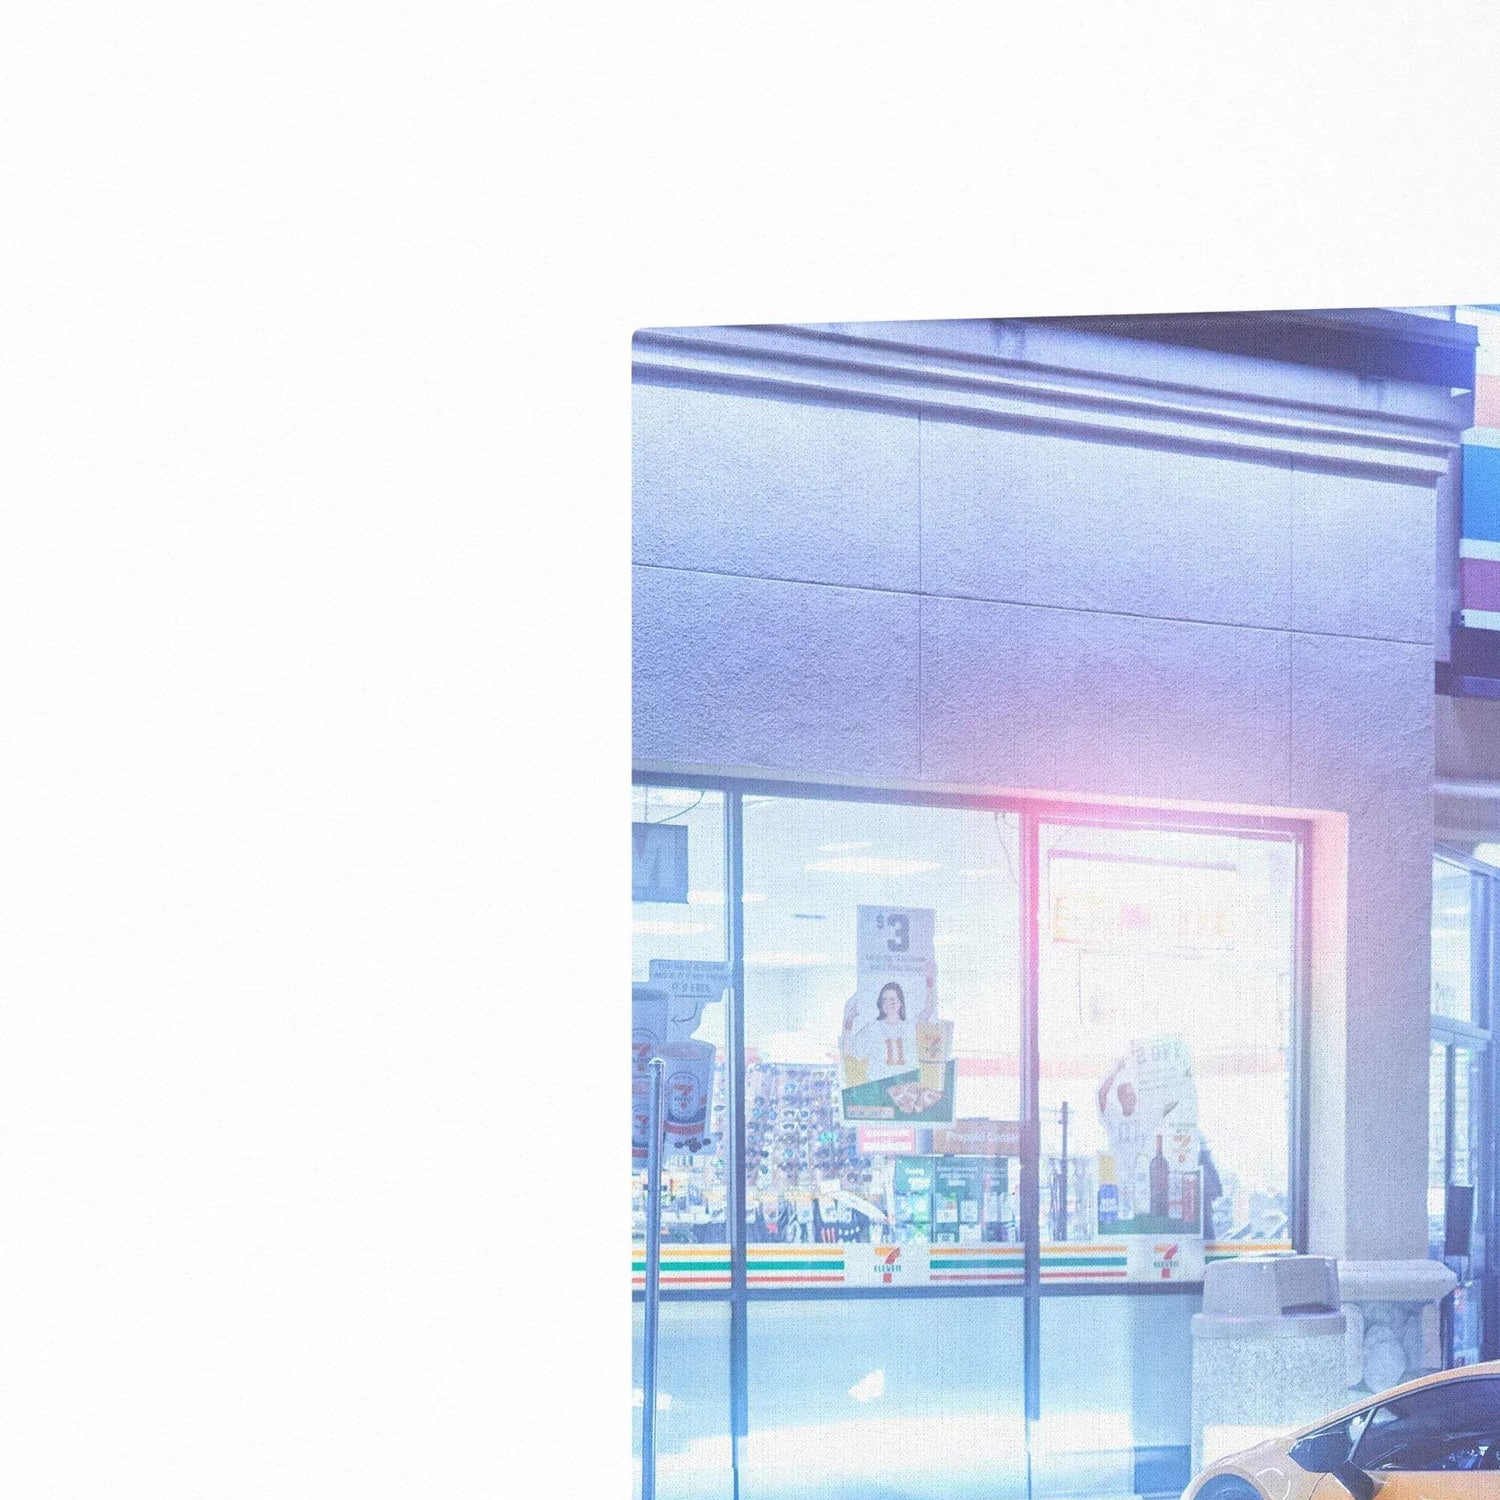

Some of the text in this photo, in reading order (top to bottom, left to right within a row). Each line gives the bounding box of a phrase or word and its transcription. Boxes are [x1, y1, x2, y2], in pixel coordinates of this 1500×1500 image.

[876, 912, 910, 953] $3
[883, 1037, 906, 1066] 11
[873, 1245, 901, 1284] 7
